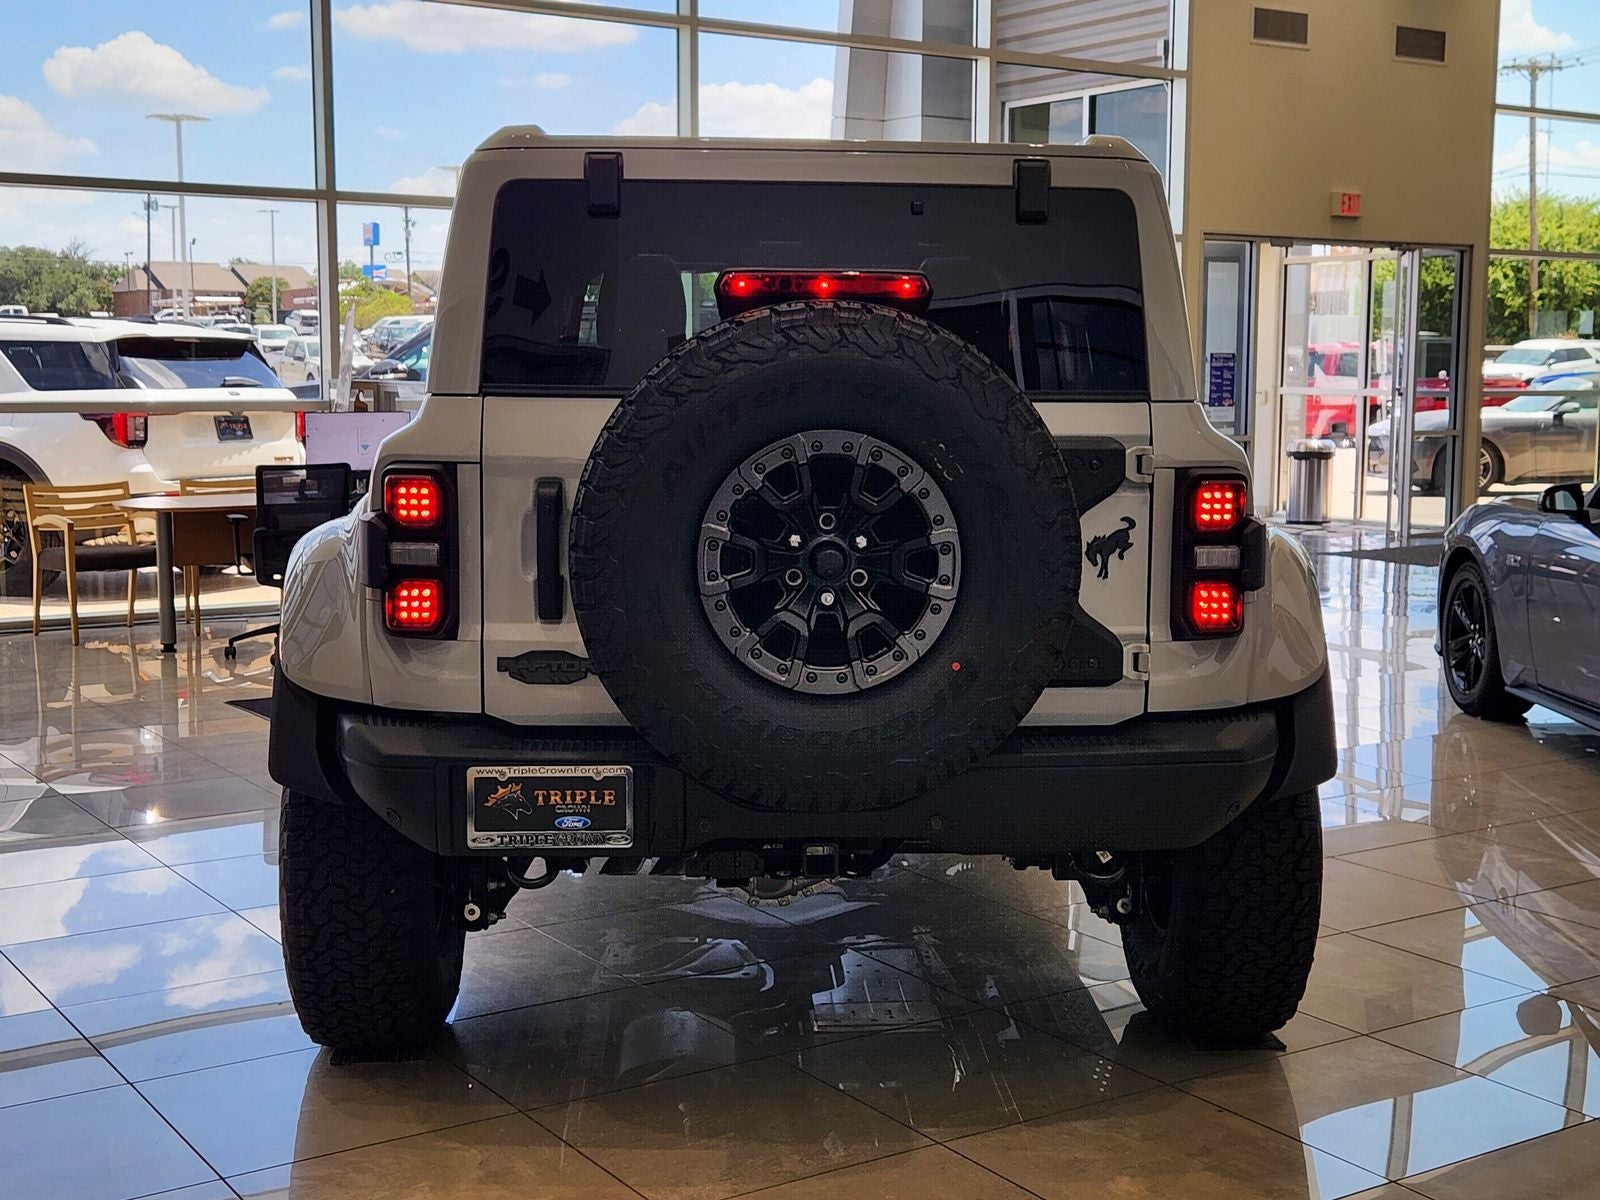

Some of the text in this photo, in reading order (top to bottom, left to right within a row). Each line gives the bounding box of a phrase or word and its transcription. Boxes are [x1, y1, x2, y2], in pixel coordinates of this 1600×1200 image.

[475, 766, 627, 775] www.TripleCrownFord.com
[534, 790, 616, 806] TRIPLE
[555, 804, 591, 813] CROWN
[561, 816, 585, 828] Ford
[496, 834, 554, 845] TRIPLE
[555, 832, 606, 846] CROWN
